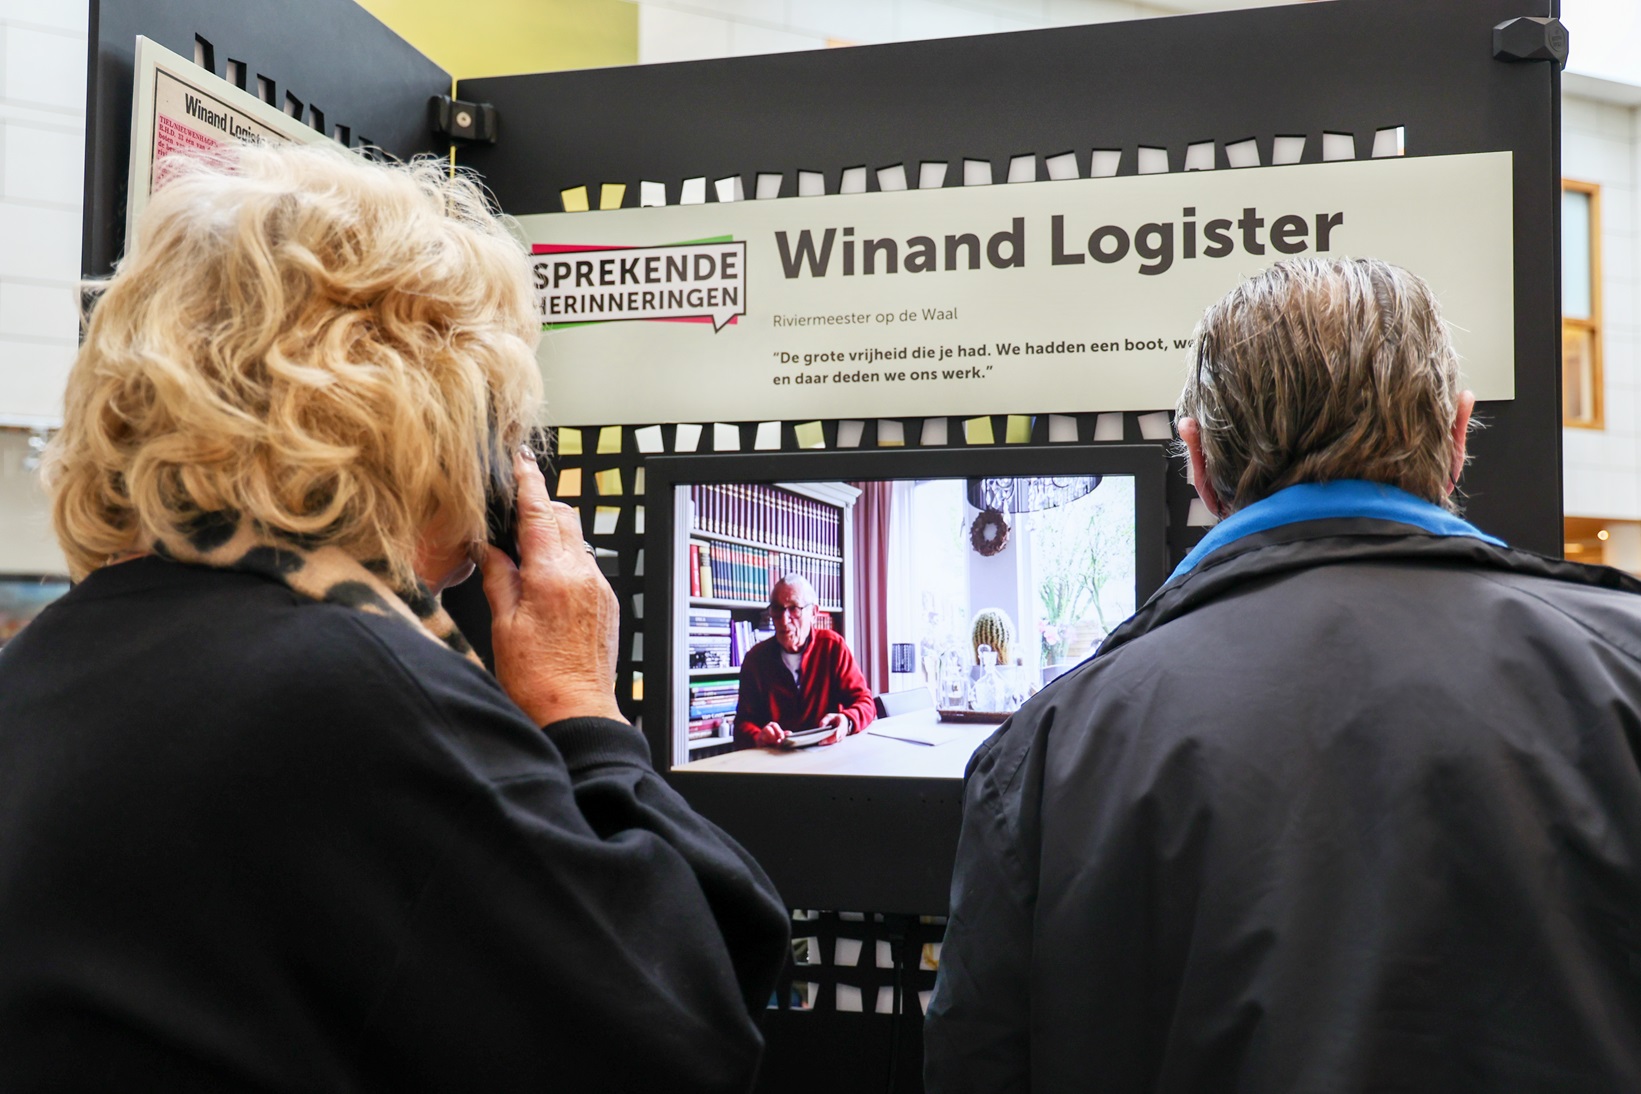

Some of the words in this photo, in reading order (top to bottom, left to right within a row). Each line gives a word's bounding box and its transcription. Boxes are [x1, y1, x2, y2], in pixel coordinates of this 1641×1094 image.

[185, 93, 228, 132] Winand
[774, 216, 1027, 279] Winand
[1049, 206, 1345, 276] Logister
[533, 252, 738, 290] SPREKENDE
[773, 312, 871, 327] Riviermeester
[875, 313, 895, 325] op
[899, 309, 917, 322] de
[921, 307, 958, 321] Waal
[803, 350, 845, 366] grote
[849, 347, 907, 364] vrijheid
[912, 346, 935, 359] die
[938, 345, 953, 361] je
[957, 344, 991, 358] had.
[996, 343, 1021, 356] We
[1025, 341, 1086, 354] hadden
[1090, 341, 1118, 352] een
[1124, 338, 1168, 352] boot,
[773, 375, 791, 385] en
[795, 373, 829, 385] daar
[832, 370, 880, 384] deden
[884, 371, 906, 382] we
[910, 369, 938, 381] ons
